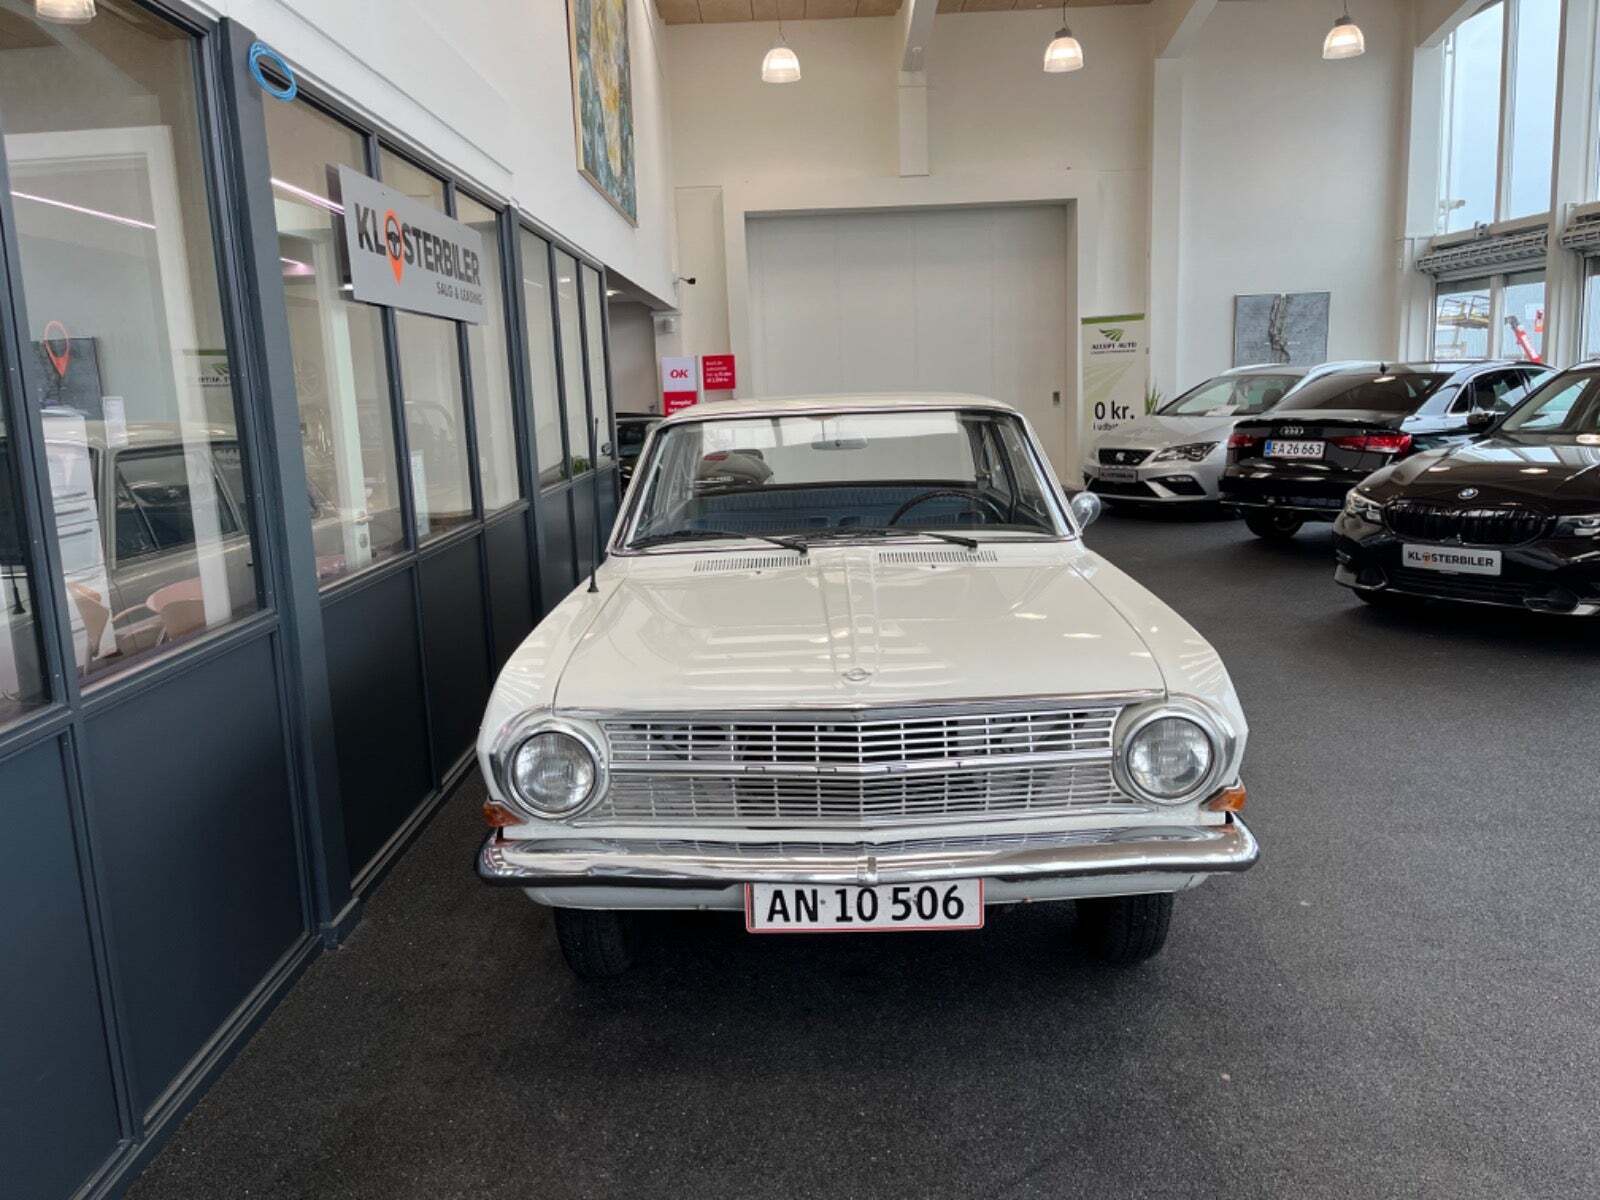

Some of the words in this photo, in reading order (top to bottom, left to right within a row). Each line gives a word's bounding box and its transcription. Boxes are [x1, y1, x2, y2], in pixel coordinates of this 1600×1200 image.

[355, 203, 481, 287] KLOSTERBILER
[670, 369, 689, 379] OK
[1094, 401, 1106, 420] 0
[1110, 400, 1136, 420] kr.
[1272, 443, 1285, 455] EA
[1286, 443, 1299, 455] 26
[1301, 443, 1321, 455] 663
[1407, 550, 1494, 568] KLOSTERBILER
[767, 889, 818, 923] AN
[834, 887, 879, 923] 10
[891, 884, 965, 922] 506
